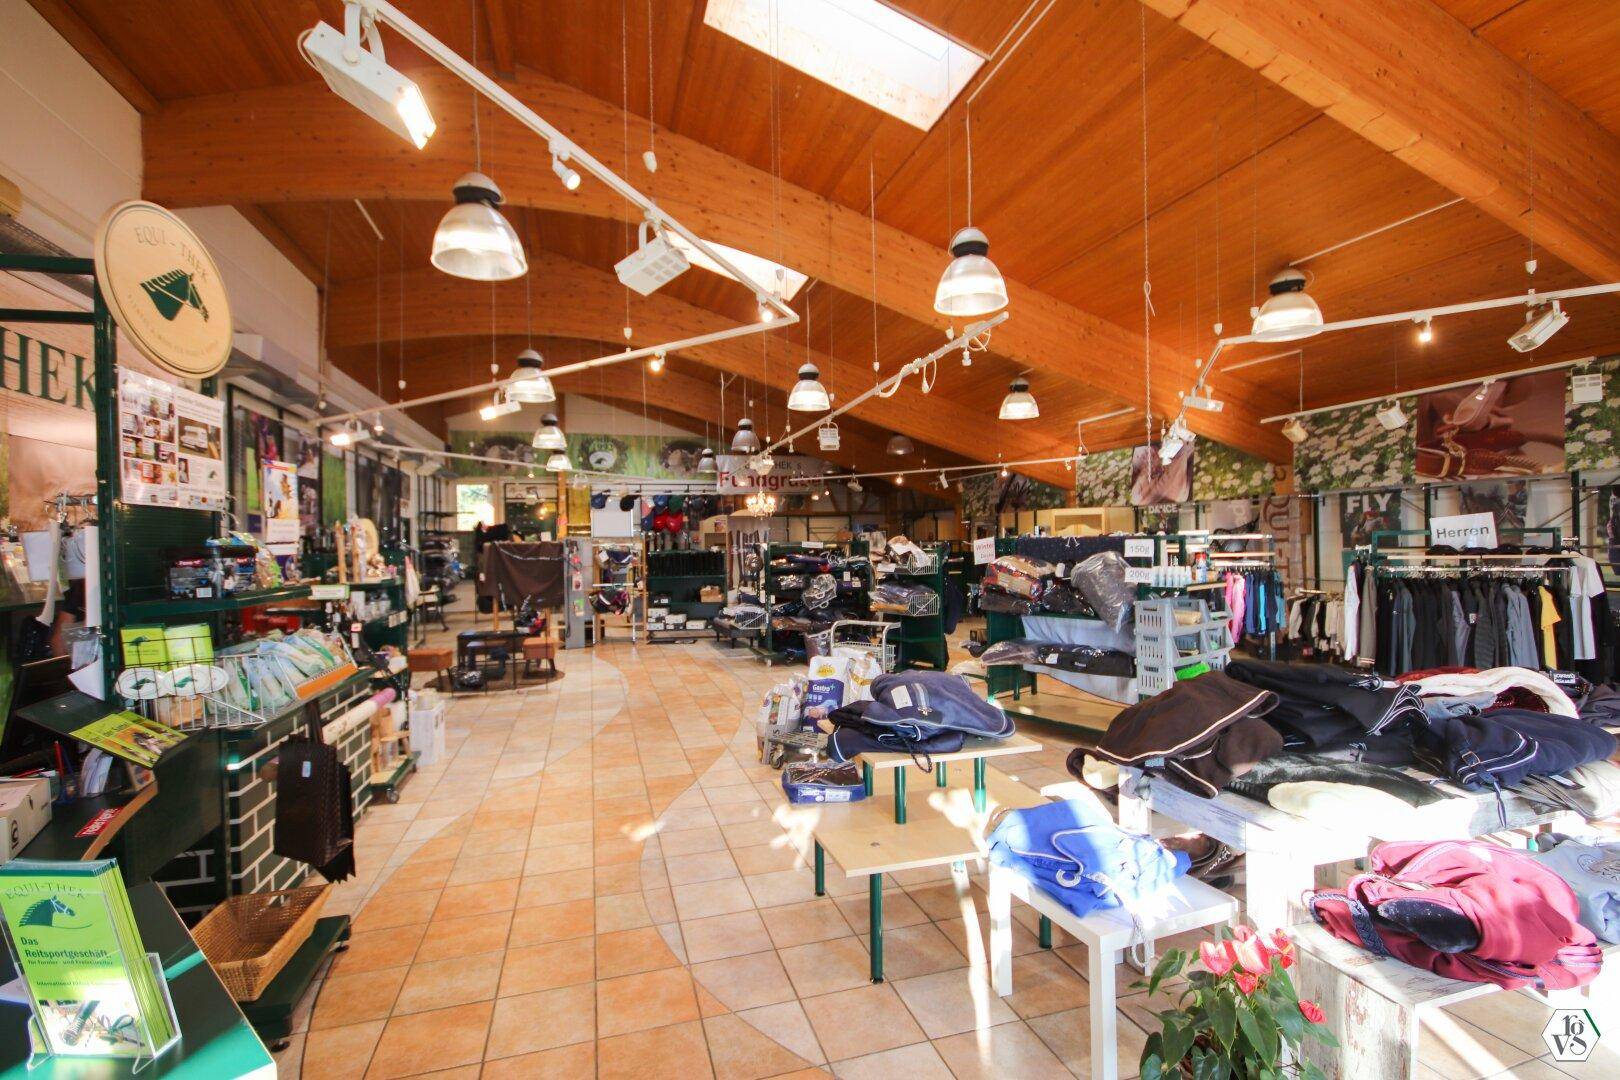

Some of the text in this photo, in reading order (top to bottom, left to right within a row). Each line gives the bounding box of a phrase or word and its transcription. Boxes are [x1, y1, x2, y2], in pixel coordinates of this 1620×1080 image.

[1346, 492, 1393, 514] FLY
[1436, 526, 1490, 540] Herren
[20, 936, 39, 946] Das
